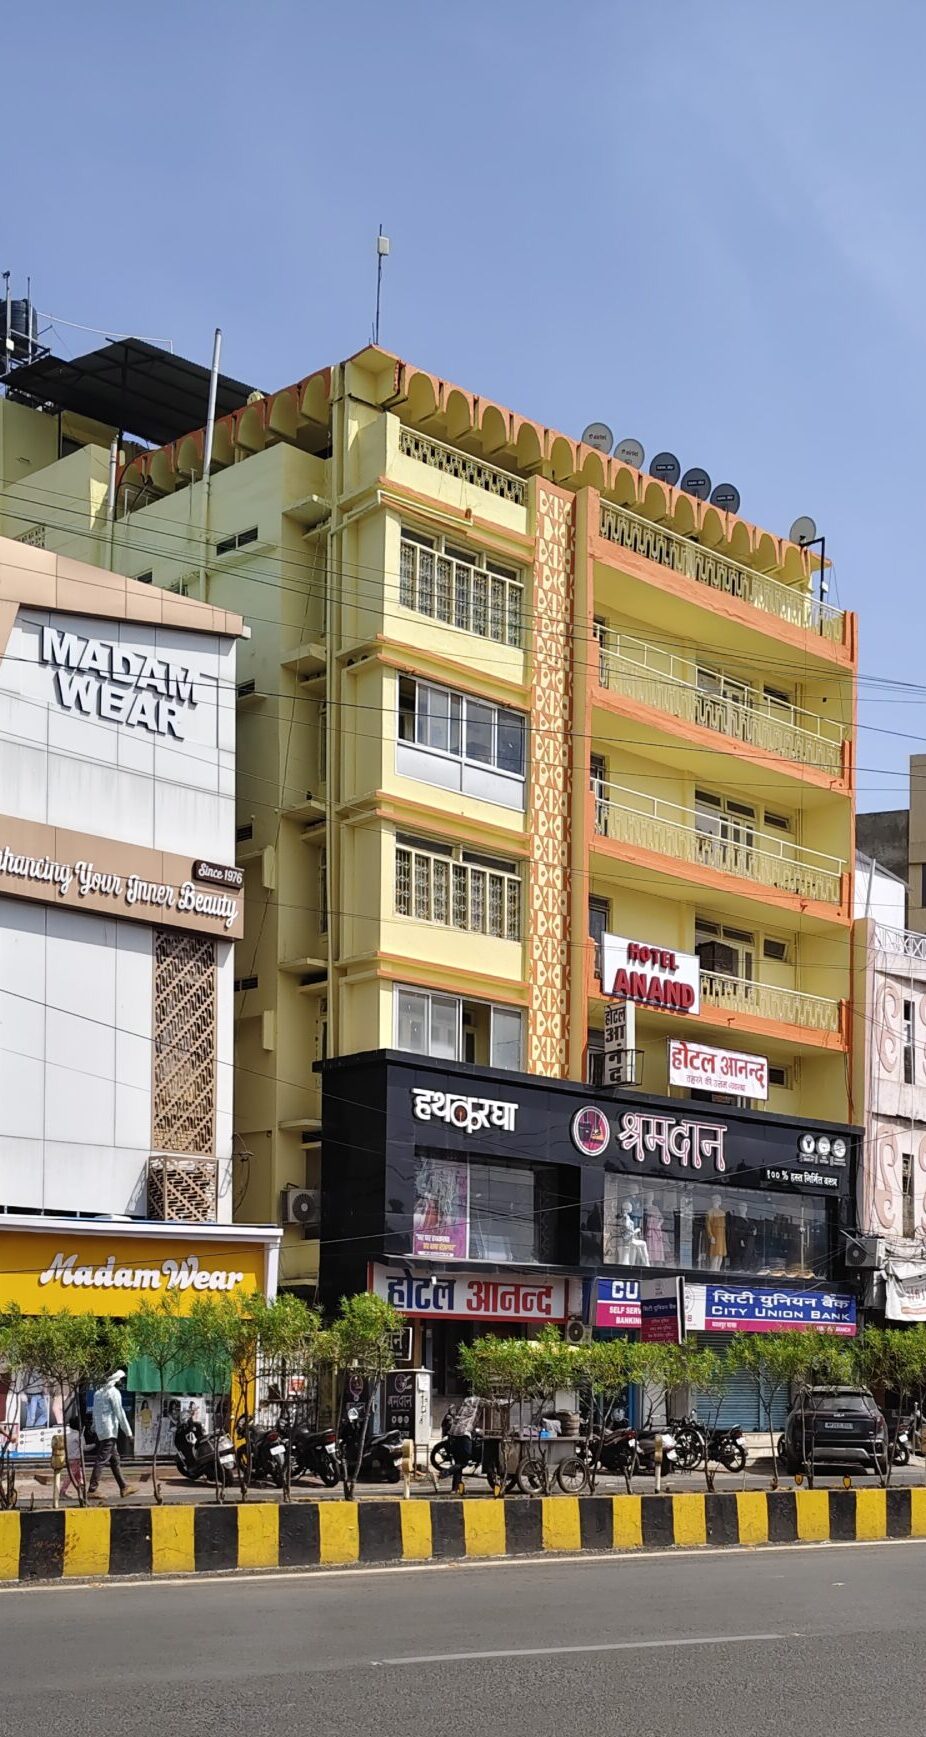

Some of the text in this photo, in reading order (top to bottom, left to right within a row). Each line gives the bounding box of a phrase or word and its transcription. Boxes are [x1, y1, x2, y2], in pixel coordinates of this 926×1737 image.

[40, 625, 199, 707] MADAM
[53, 669, 185, 741] WEAR
[75, 860, 123, 896] Your
[127, 874, 175, 906] Inner
[178, 881, 239, 928] Beauty
[198, 863, 243, 884] Since 1976
[627, 942, 678, 971] HOTEL
[613, 968, 696, 1010] ANAND
[671, 1041, 768, 1088] होटल आनन्द
[412, 1087, 519, 1134] हथकरघा
[617, 1111, 728, 1173] श्रमदान
[39, 1252, 244, 1291] Madam Wear
[385, 1268, 554, 1316] होटल आनन्द
[609, 1305, 625, 1315] SELF
[712, 1290, 756, 1305] सिटी
[820, 1293, 851, 1309] बैंक
[755, 1308, 804, 1319] UNION
[810, 1310, 850, 1321] BANK
